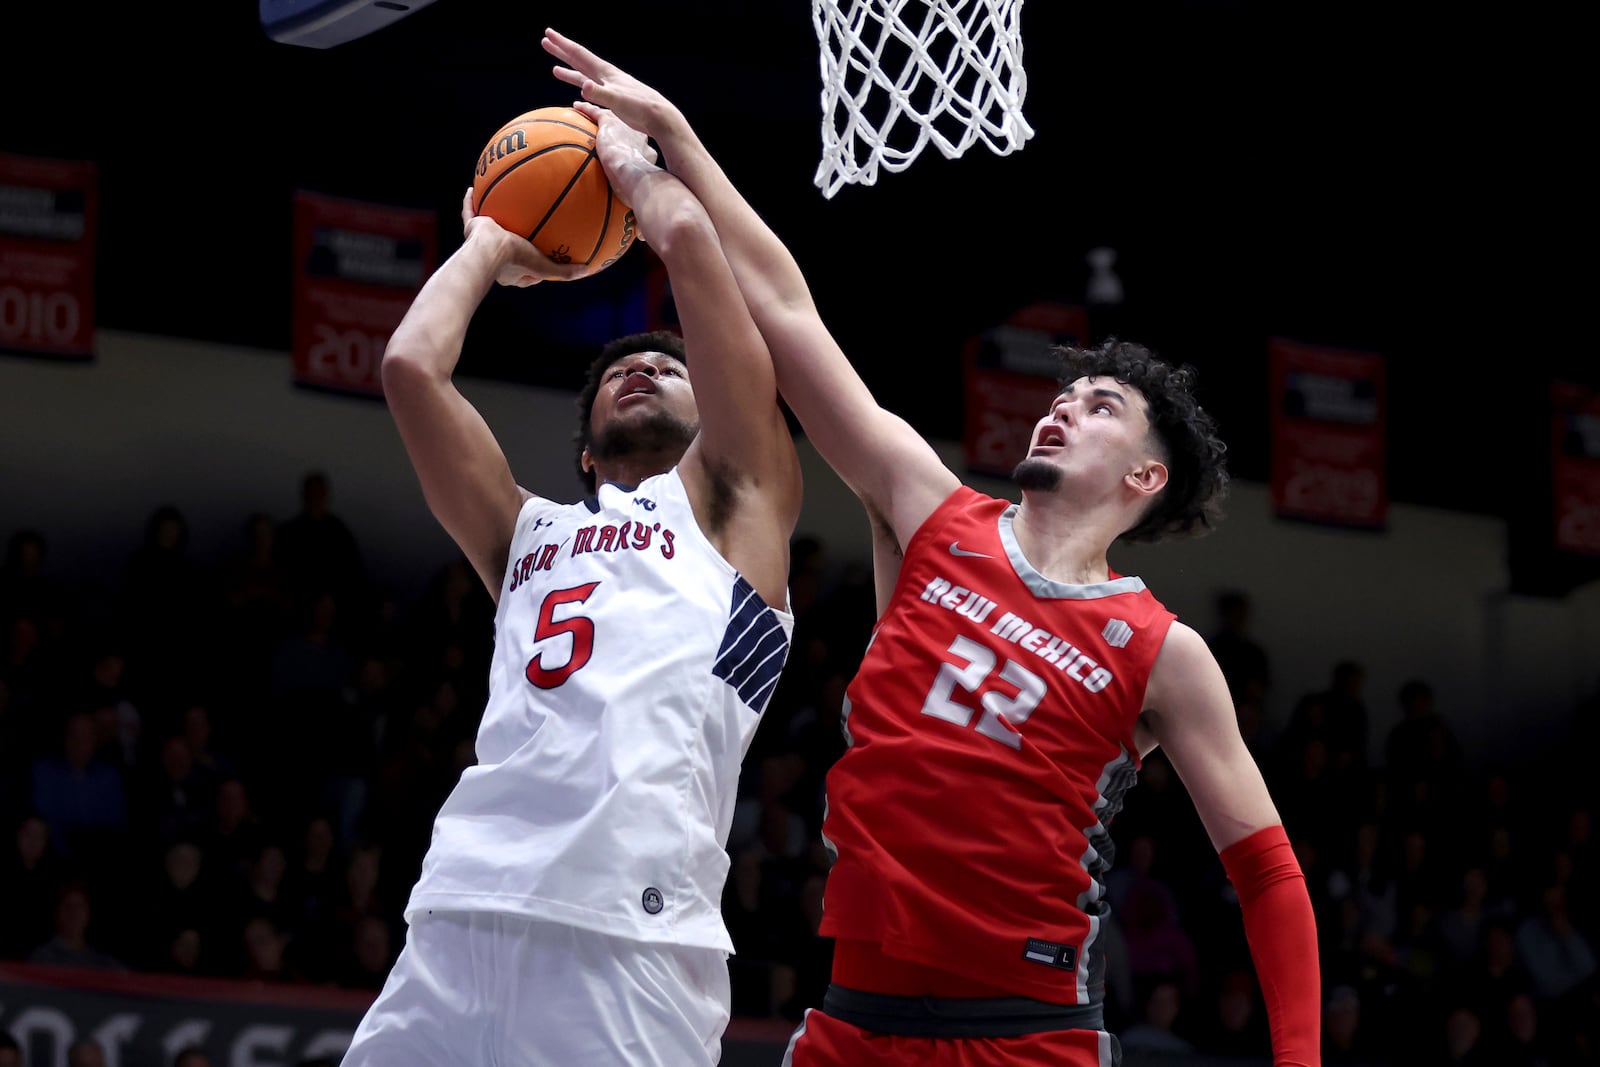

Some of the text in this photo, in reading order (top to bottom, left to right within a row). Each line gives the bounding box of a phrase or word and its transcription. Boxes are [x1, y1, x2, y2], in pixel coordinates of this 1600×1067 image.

[571, 520, 675, 560] MARY'S
[525, 580, 602, 690] 5
[920, 576, 998, 624] NEW
[989, 610, 1113, 694] MEXICO
[920, 633, 1048, 751] 22
[1062, 951, 1070, 964] L
